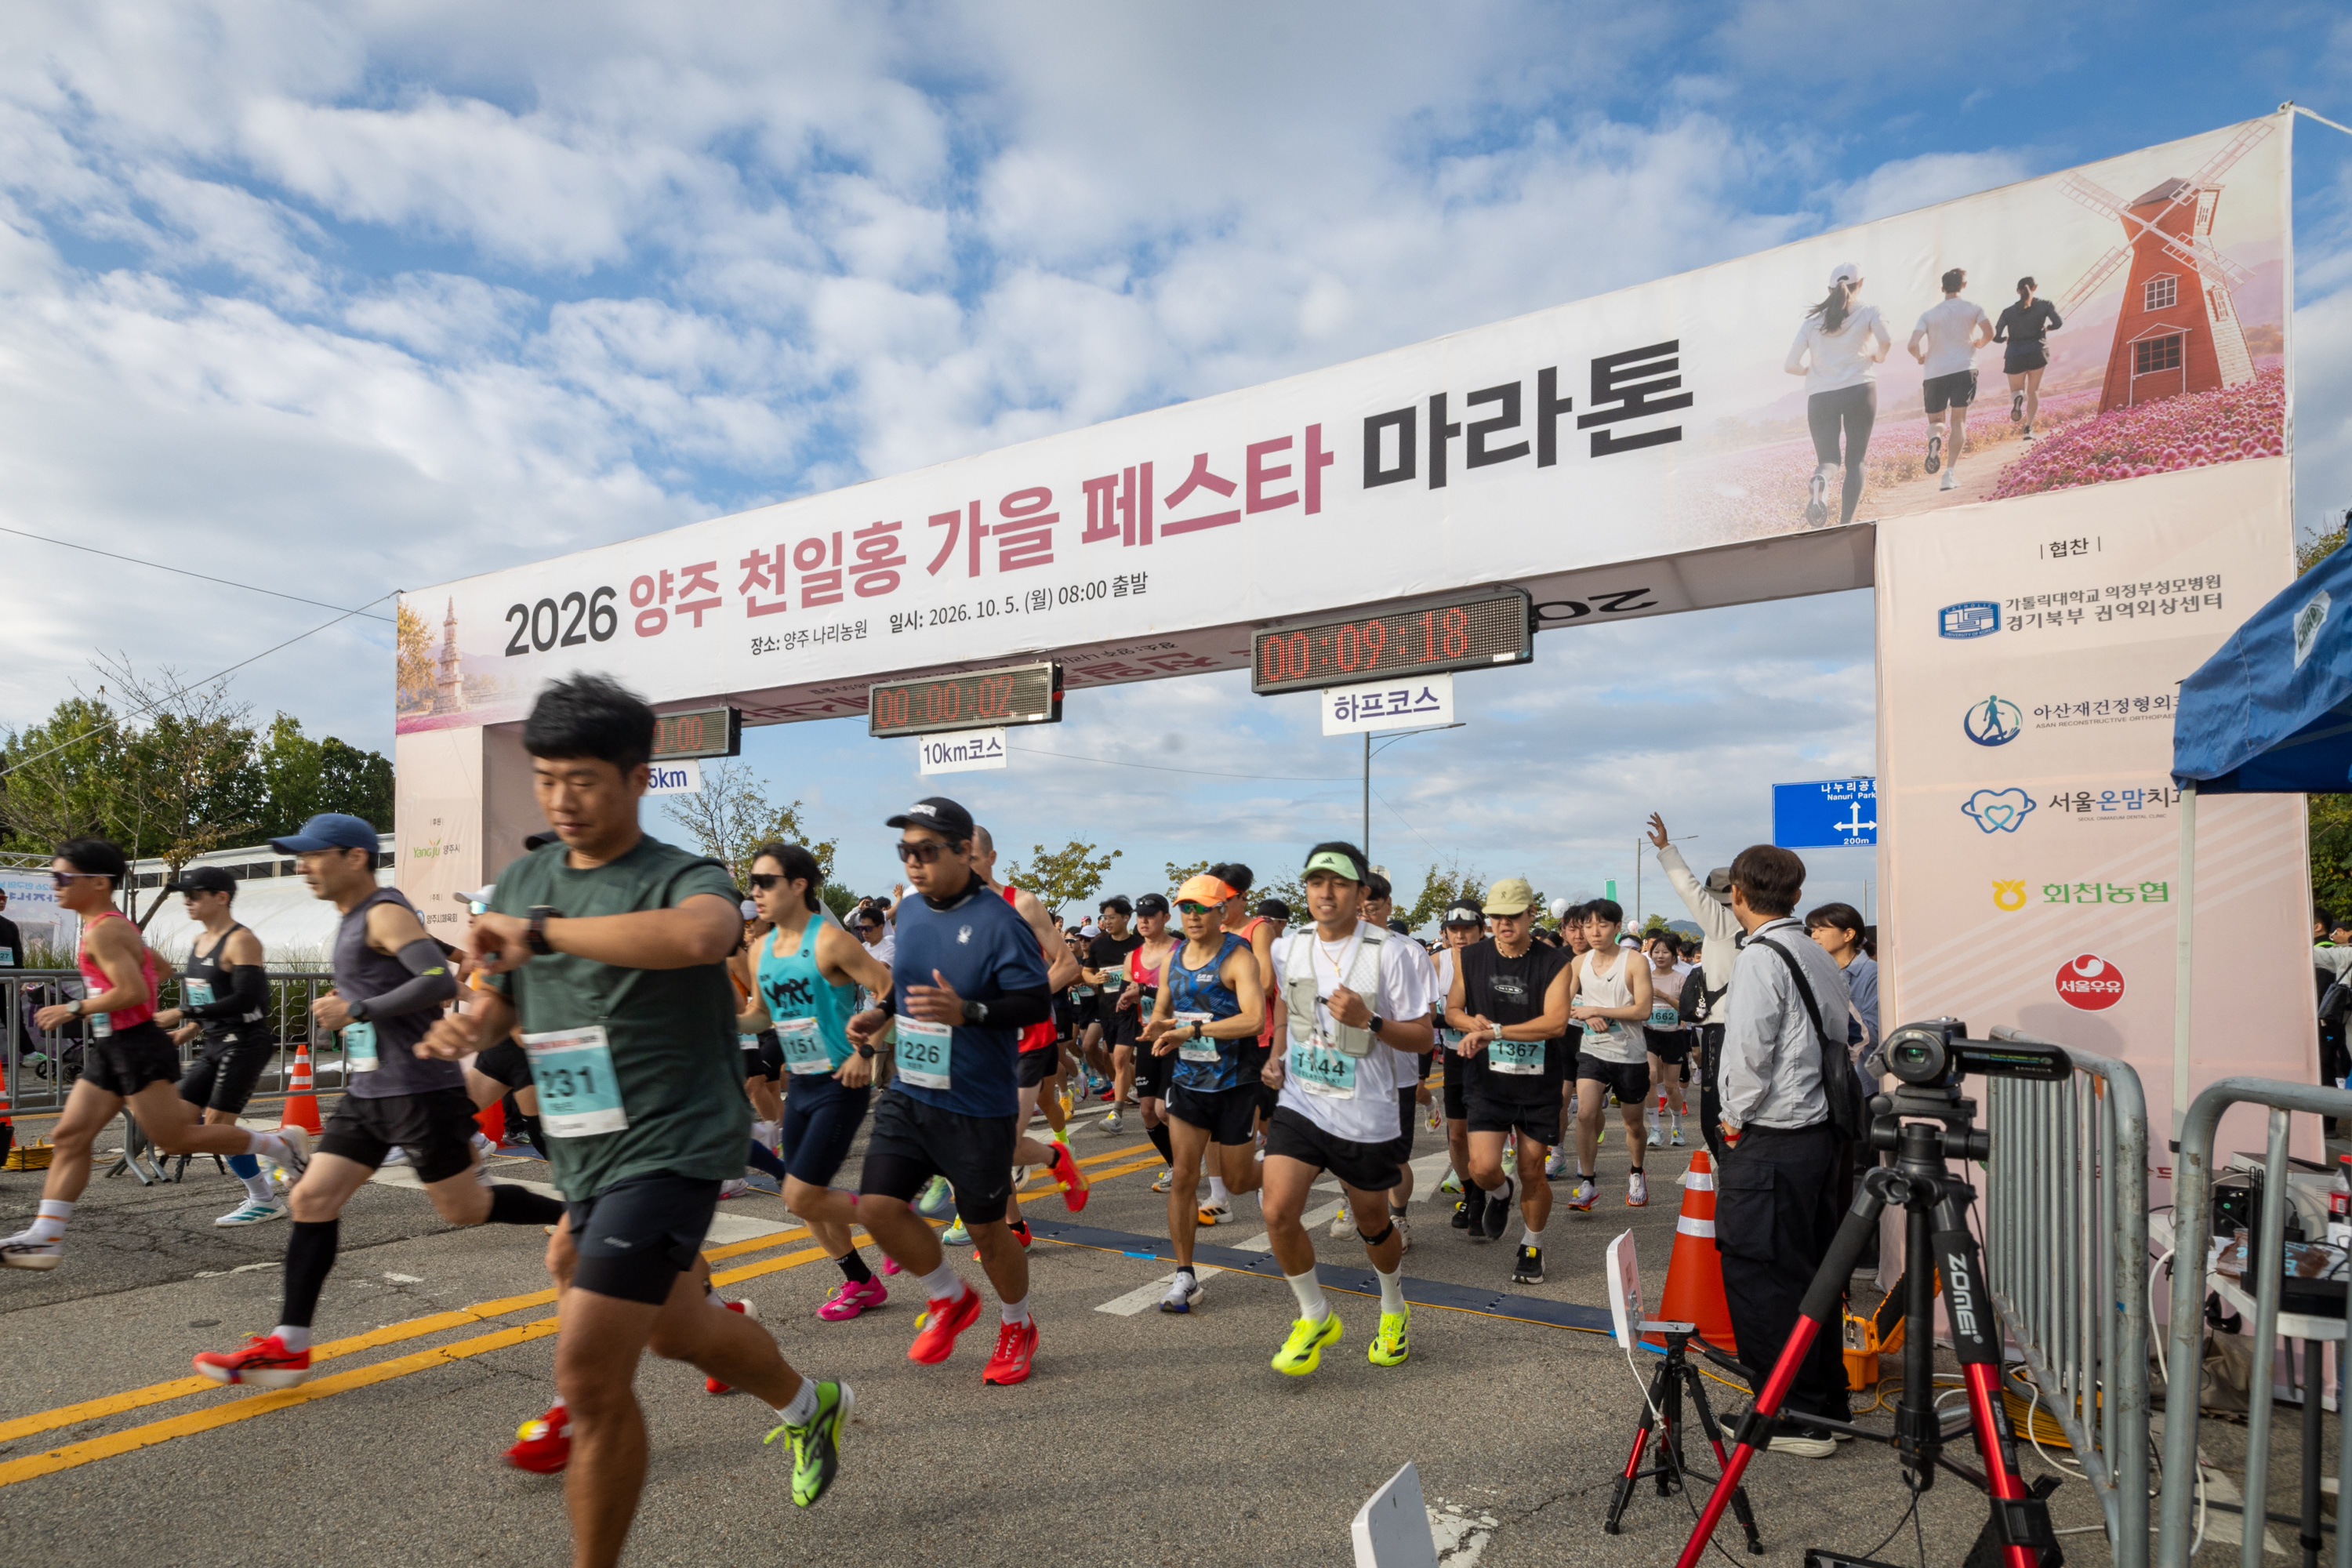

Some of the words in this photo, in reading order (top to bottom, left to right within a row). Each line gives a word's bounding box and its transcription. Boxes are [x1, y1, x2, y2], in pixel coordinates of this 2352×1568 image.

[506, 586, 617, 657] 2026
[630, 561, 721, 637] 양주
[739, 521, 907, 619] 천일홍
[927, 487, 1059, 578] 가을
[1082, 423, 1334, 546] 페스타
[1363, 339, 1693, 490] 마라톤
[2049, 538, 2089, 557] 협찬
[2006, 589, 2100, 611] 가톨릭대학교
[2105, 575, 2222, 600] 의정부성모병원
[751, 637, 779, 655] 장소:
[784, 630, 809, 650] 양주
[814, 619, 866, 644] 나리농원
[890, 611, 923, 633] 일시:
[930, 604, 971, 626] 2026.
[977, 600, 1000, 618] 10.
[1005, 597, 1018, 613] 5.
[1025, 588, 1052, 614] (월)
[1059, 580, 1106, 604] 08:00
[1112, 572, 1148, 597] 출발
[1945, 603, 1992, 613] CATHOLIC
[2007, 608, 2084, 631] 경기북부
[2094, 593, 2223, 622] 권역외상센터
[1262, 607, 1469, 682] 00:09:18
[877, 675, 1014, 728] 00:00:02
[1335, 687, 1439, 722] 하프코스
[2034, 694, 2180, 721] 아산재건정형외
[2058, 717, 2127, 727] RECONSTRUCTIVE
[924, 737, 1003, 764] 10km코스
[648, 768, 688, 789] 5km
[1827, 792, 1853, 800] Nanuri
[1857, 790, 1876, 799] Park
[443, 844, 460, 855] 양주시
[2042, 880, 2169, 905] 회천농협
[426, 913, 458, 924] 양주시체육회
[2058, 979, 2122, 994] 서울우유
[898, 1039, 941, 1064] 1226
[1497, 1043, 1538, 1057] 1367
[1298, 1051, 1345, 1076] 1144
[1948, 1253, 1977, 1335] ZOMEI
